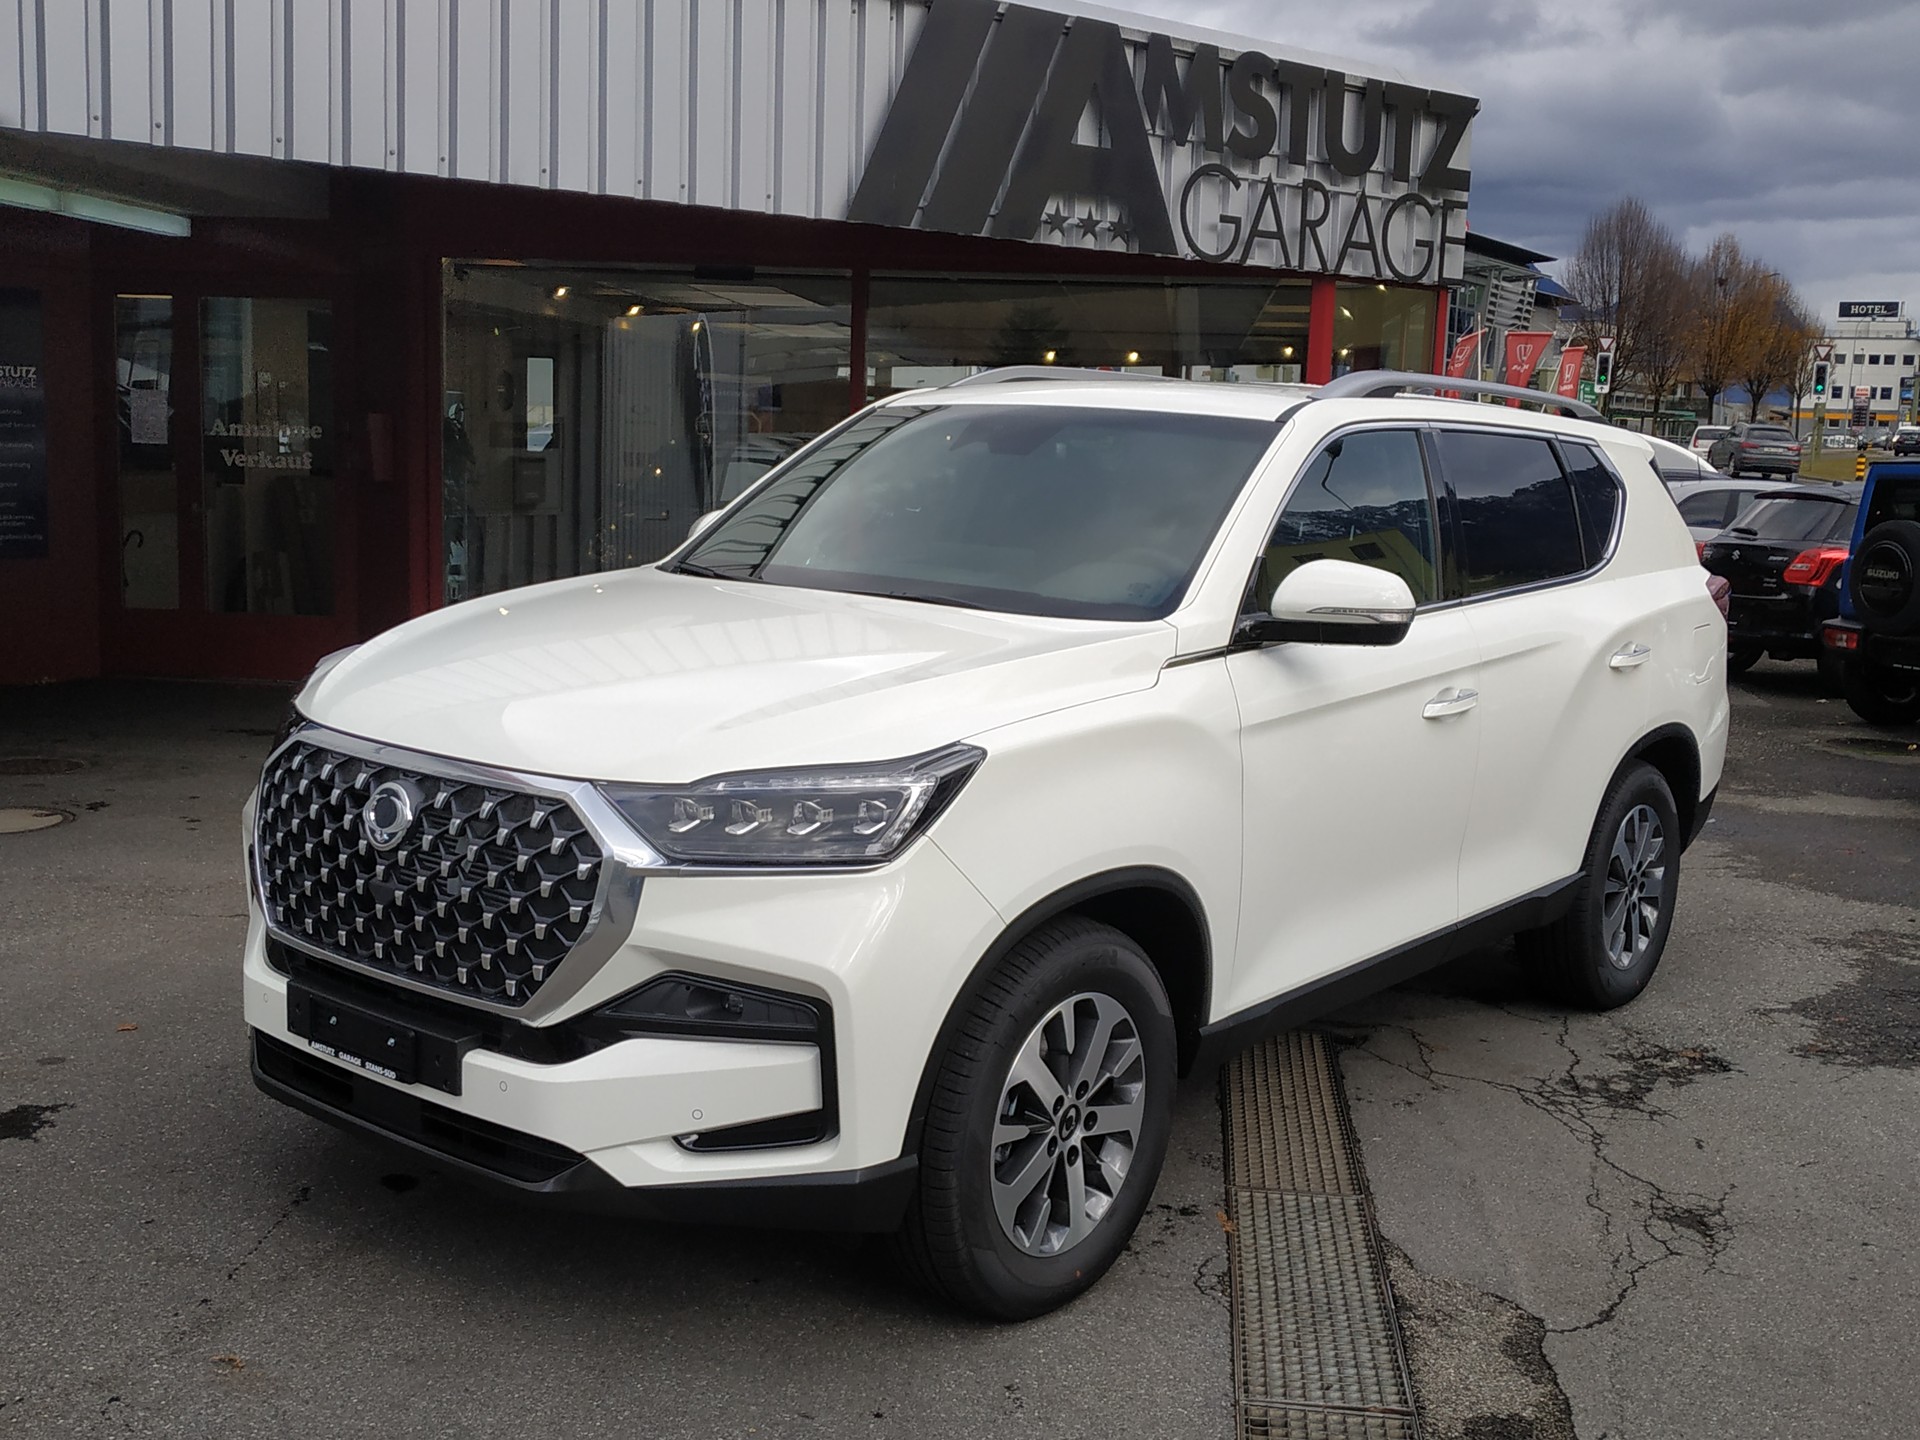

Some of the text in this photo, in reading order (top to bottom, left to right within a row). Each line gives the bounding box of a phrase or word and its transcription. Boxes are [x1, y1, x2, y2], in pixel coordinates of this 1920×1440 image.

[990, 15, 1480, 257] AMSTUTZ
[1180, 162, 1468, 287] GARAGE
[1850, 304, 1888, 315] HOTEL
[220, 449, 313, 469] Verkauf
[1866, 568, 1900, 580] SUZUKI
[311, 1041, 335, 1056] AMSTUTZ
[338, 1052, 361, 1067] GARAGE
